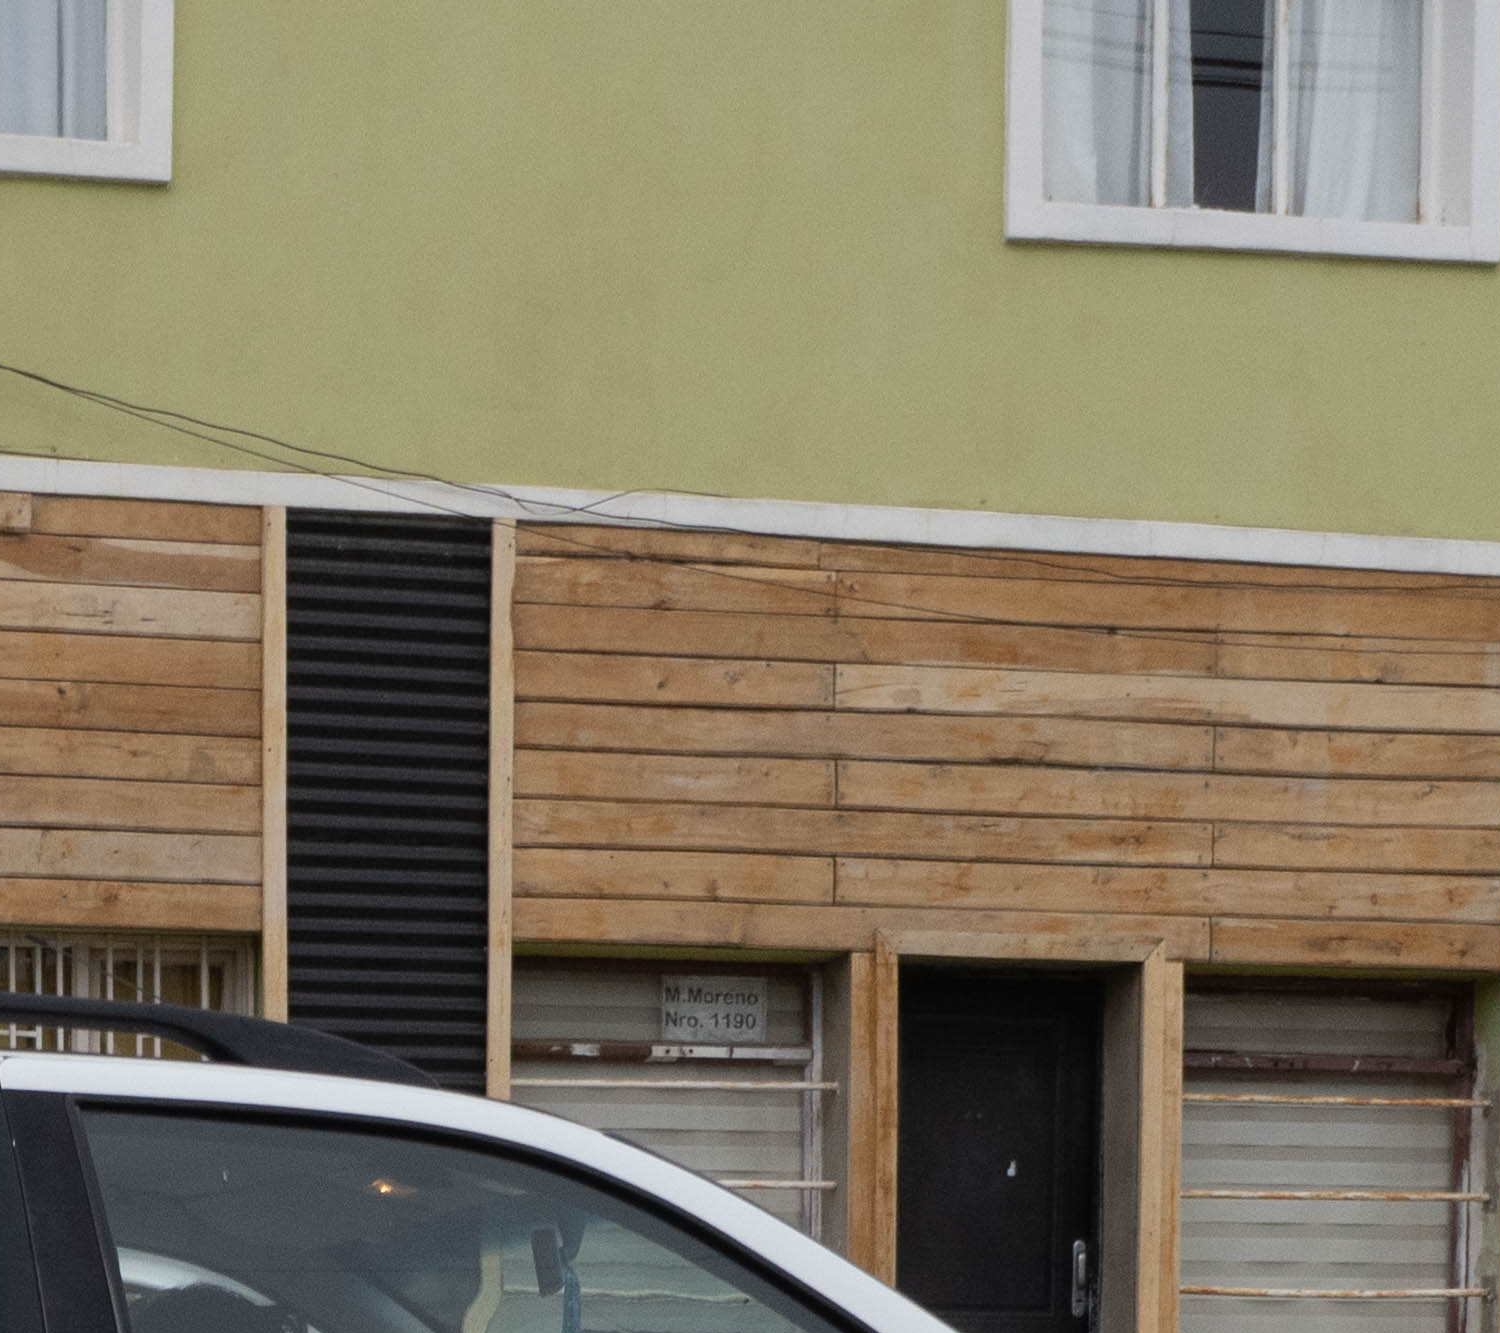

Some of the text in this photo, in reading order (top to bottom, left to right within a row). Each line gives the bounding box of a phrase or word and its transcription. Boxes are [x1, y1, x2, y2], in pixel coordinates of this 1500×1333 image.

[664, 986, 759, 1006] M.Moreno
[664, 1011, 757, 1031] Nro. 1190
